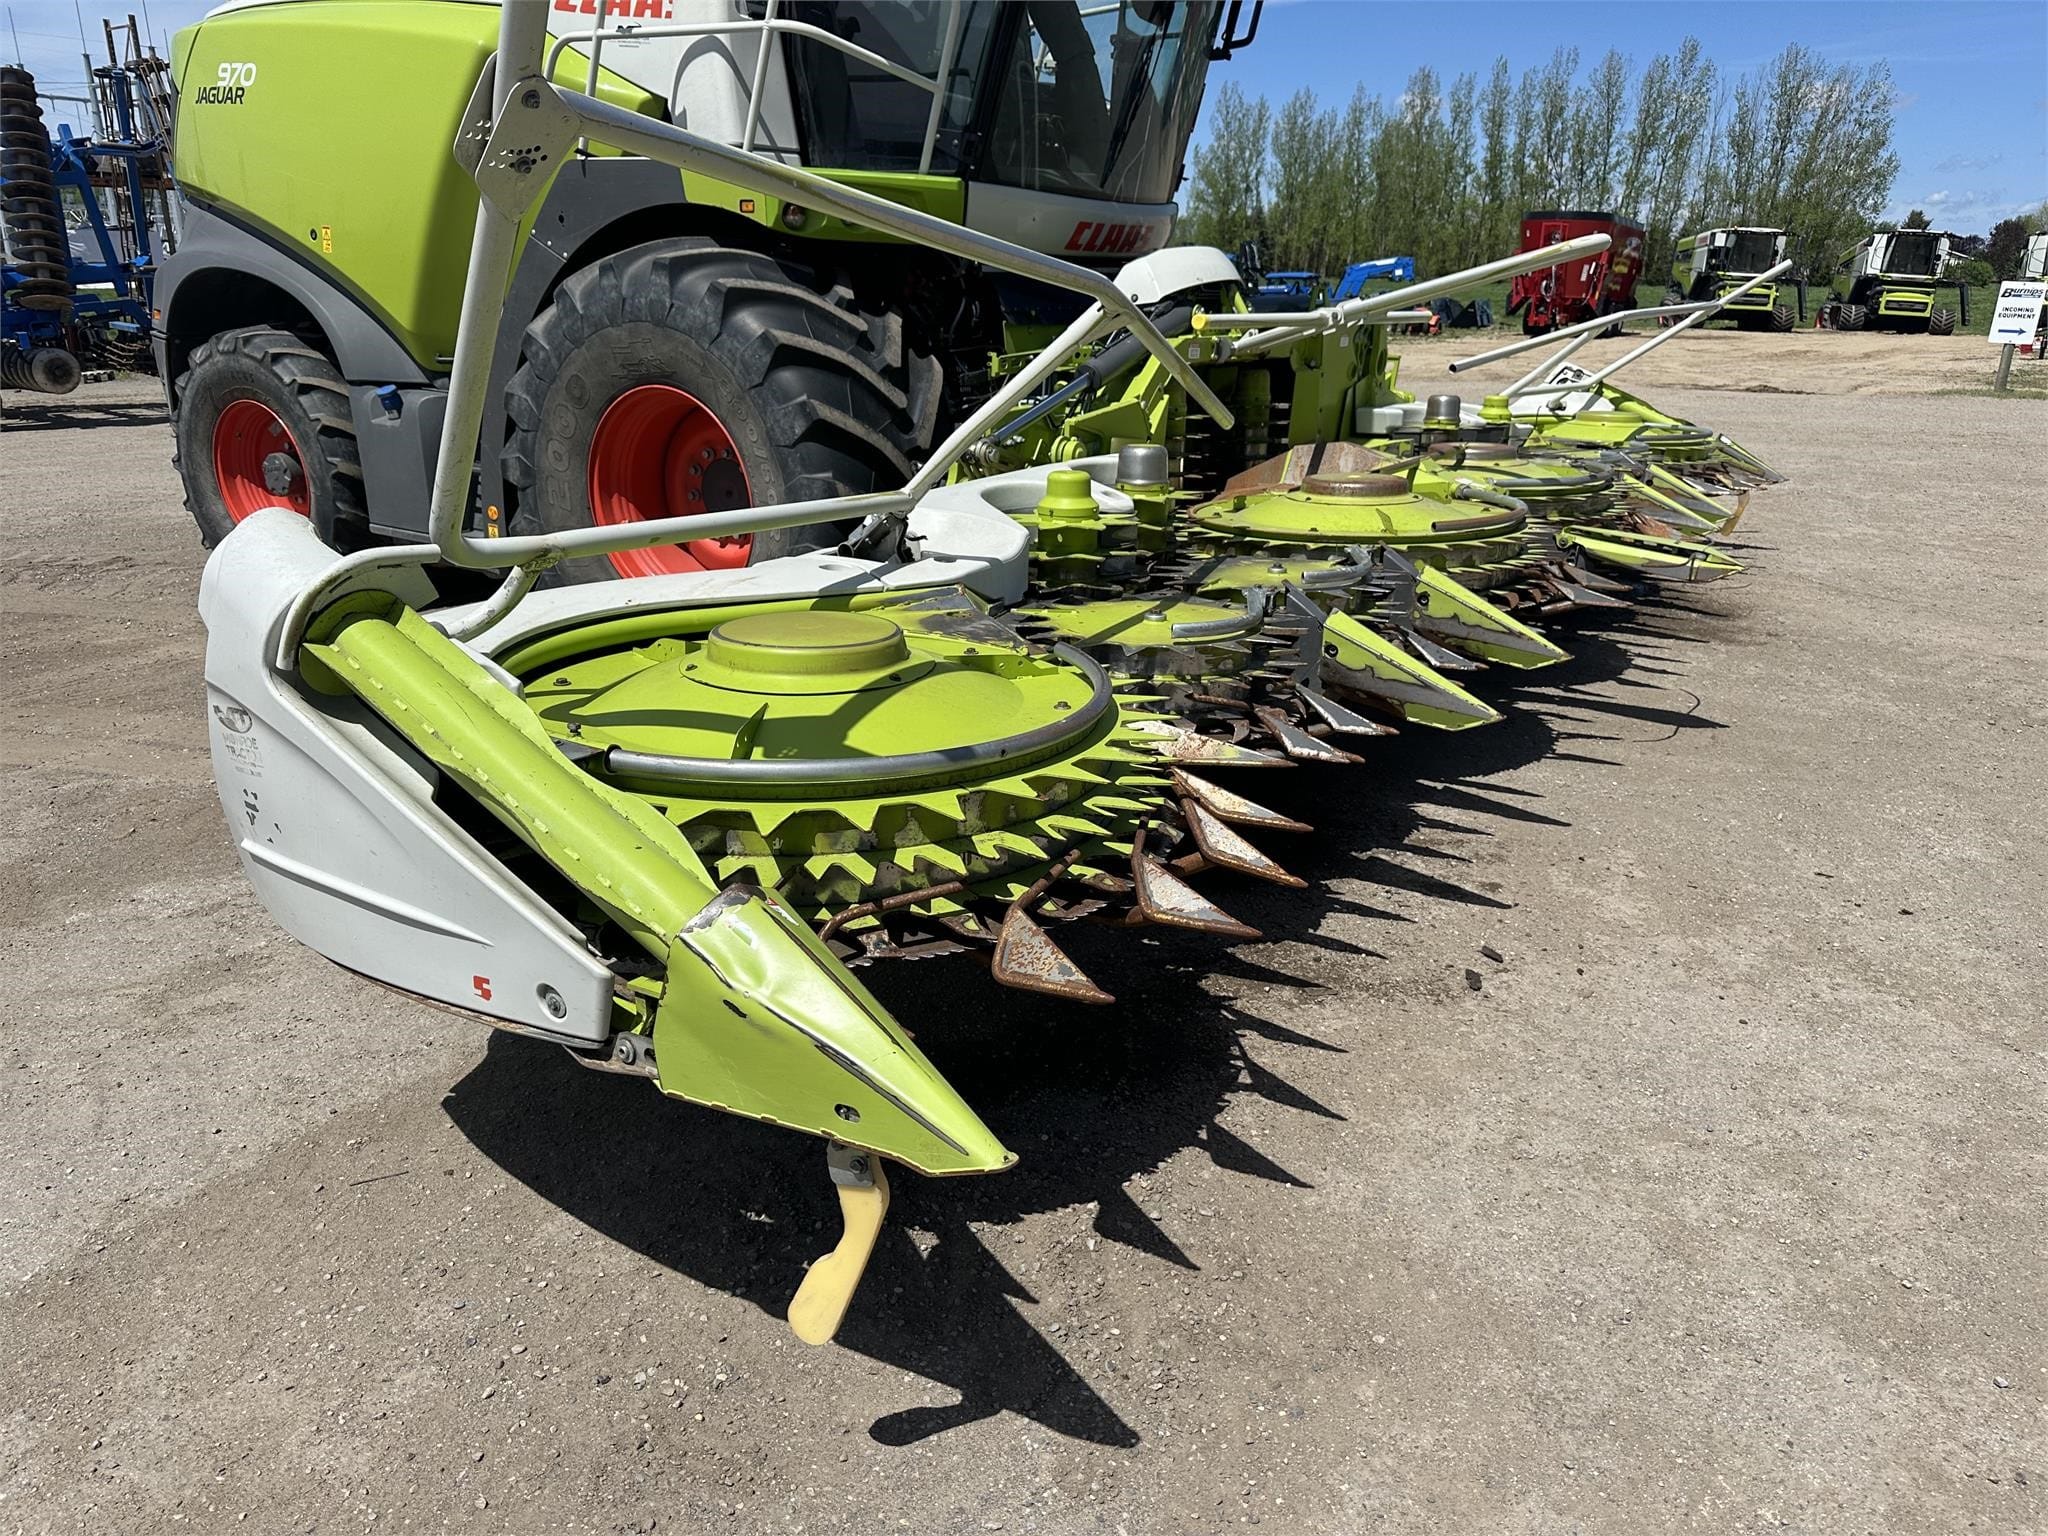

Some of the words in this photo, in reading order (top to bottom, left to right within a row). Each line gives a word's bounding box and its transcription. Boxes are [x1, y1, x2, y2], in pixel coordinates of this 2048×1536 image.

[217, 62, 257, 87] 970
[195, 86, 245, 105] JAGUAR
[1064, 221, 1155, 253] CLAAS
[2000, 287, 2044, 299] Burnips
[1998, 312, 2036, 320] EQUIPMENT
